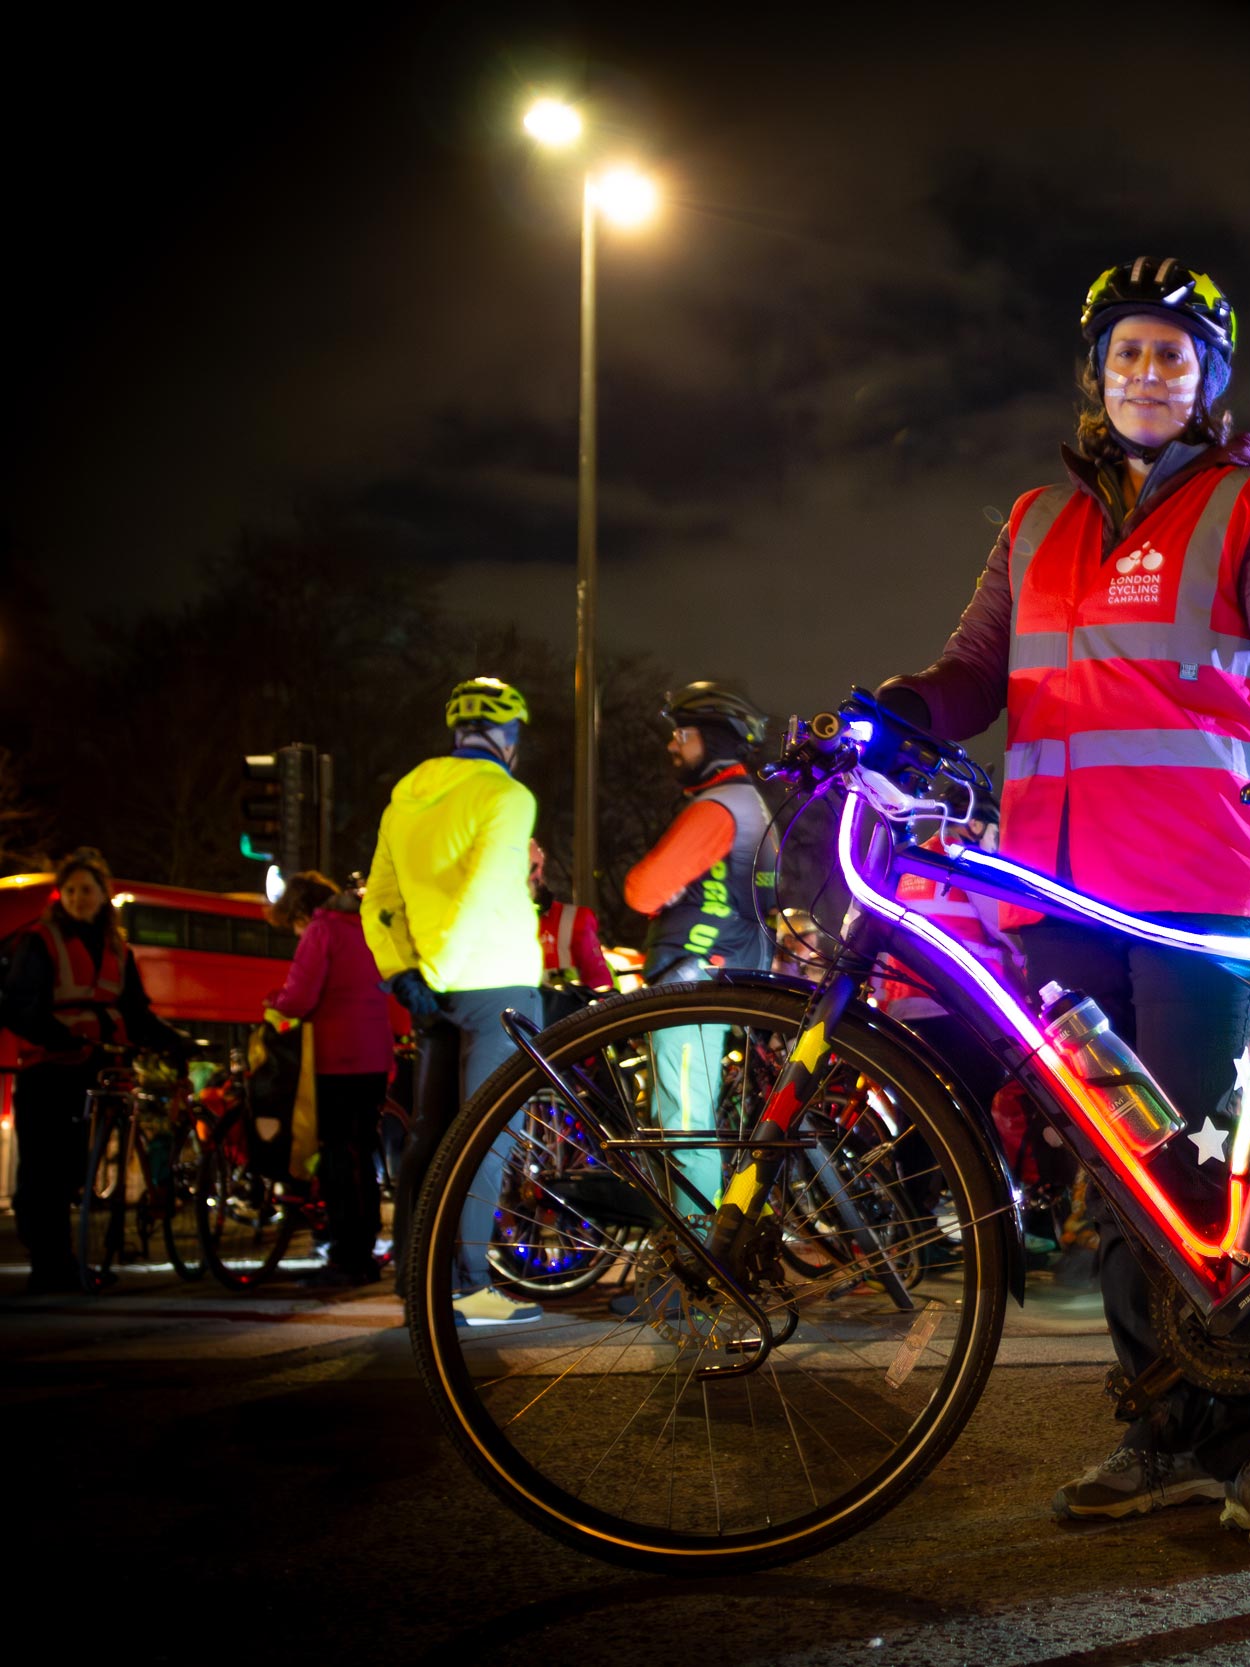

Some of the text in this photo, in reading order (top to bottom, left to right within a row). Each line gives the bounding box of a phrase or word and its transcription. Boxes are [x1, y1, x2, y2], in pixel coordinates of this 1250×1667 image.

[1110, 574, 1160, 585] LONDON
[1108, 584, 1159, 595] CYCLING
[1108, 595, 1158, 604] CAMPAIGN
